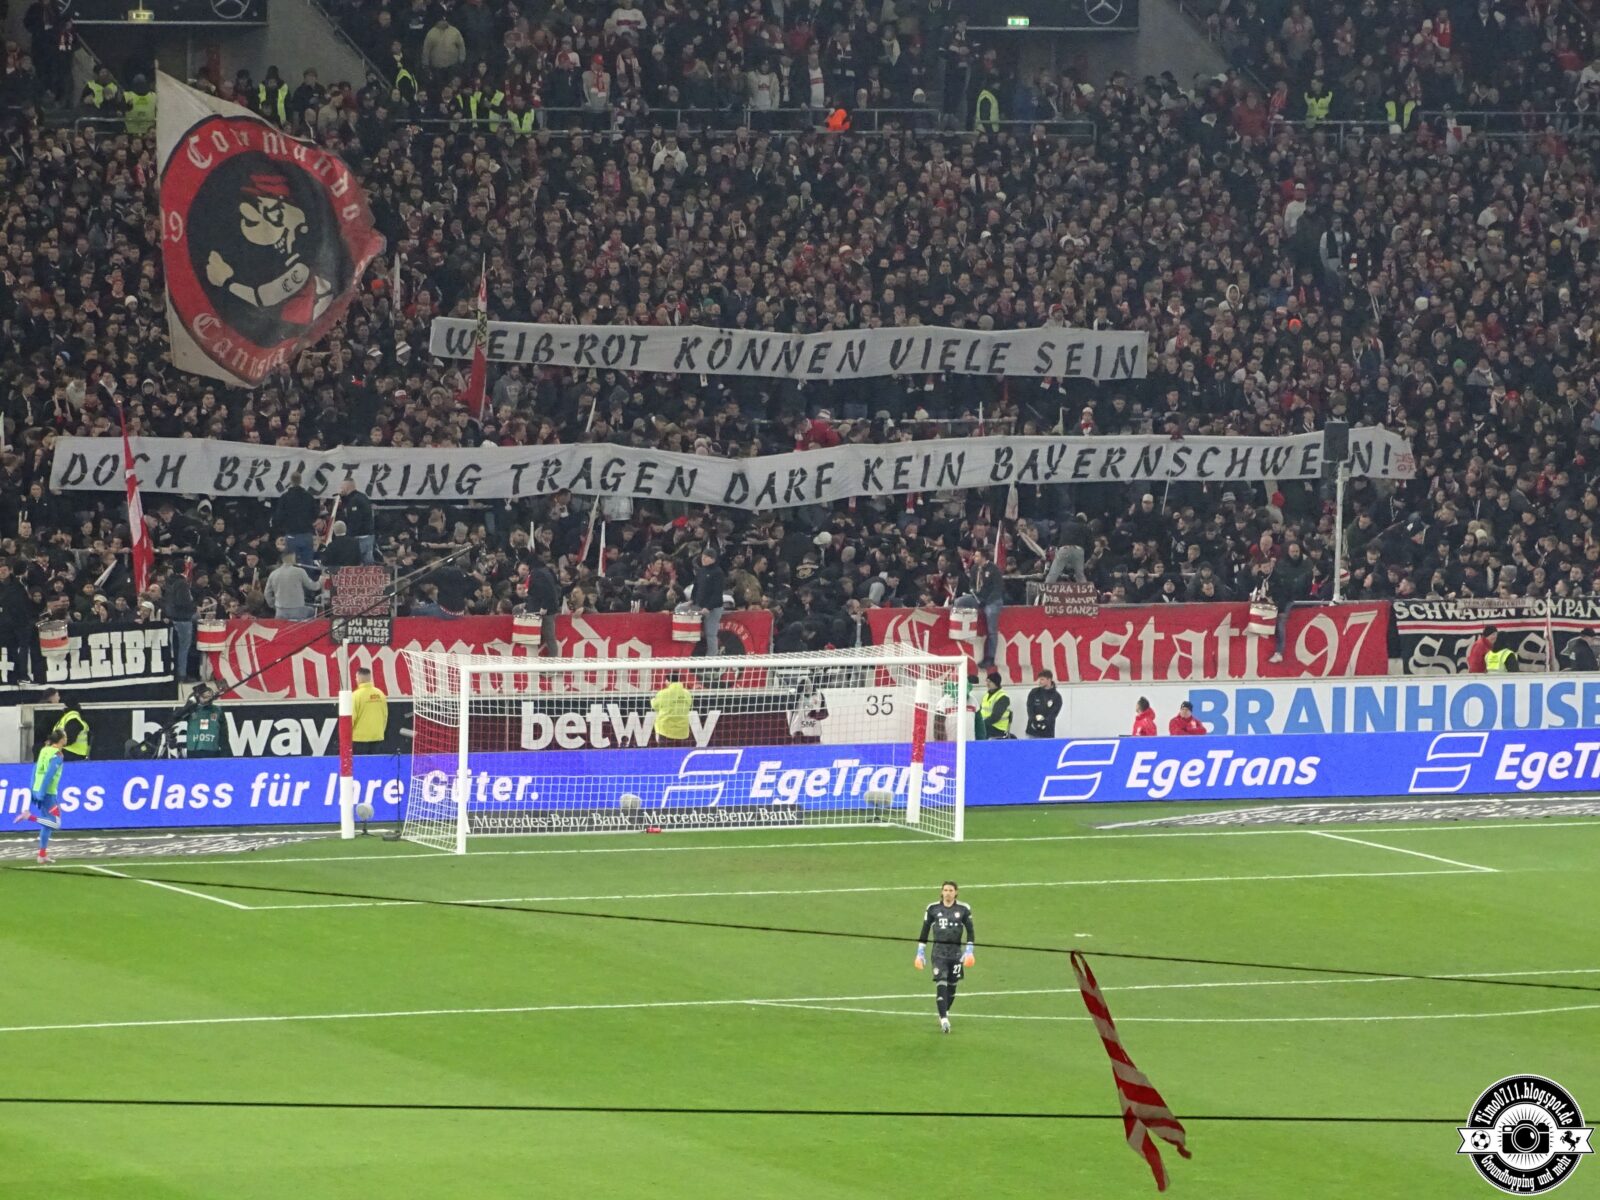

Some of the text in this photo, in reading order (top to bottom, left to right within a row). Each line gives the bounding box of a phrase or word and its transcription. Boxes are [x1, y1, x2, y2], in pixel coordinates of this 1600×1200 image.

[674, 329, 866, 375] KÖNNEN
[888, 337, 1011, 374] VIELE
[1034, 342, 1139, 379] SEIN
[60, 453, 187, 488] DOCH
[213, 455, 482, 497] BRUSTRING
[510, 457, 698, 497] TRAGEN
[723, 462, 834, 504] DARF
[862, 451, 966, 491] KEIN
[990, 441, 1391, 483] BAYERNSCHWEN!
[347, 626, 389, 636] IMMER
[366, 618, 390, 627] BIST
[1295, 610, 1378, 677] 97
[866, 694, 893, 716] 35
[131, 709, 338, 757] bway
[193, 733, 215, 742] HOST
[520, 701, 721, 750] betwy
[1126, 750, 1320, 799] EgeTrans
[122, 774, 234, 811] Class
[250, 772, 309, 808] für
[474, 812, 631, 829] Mercedes-Benz Bank
[643, 806, 797, 825] Mercedes-Benz Bank
[952, 964, 962, 975] 27
